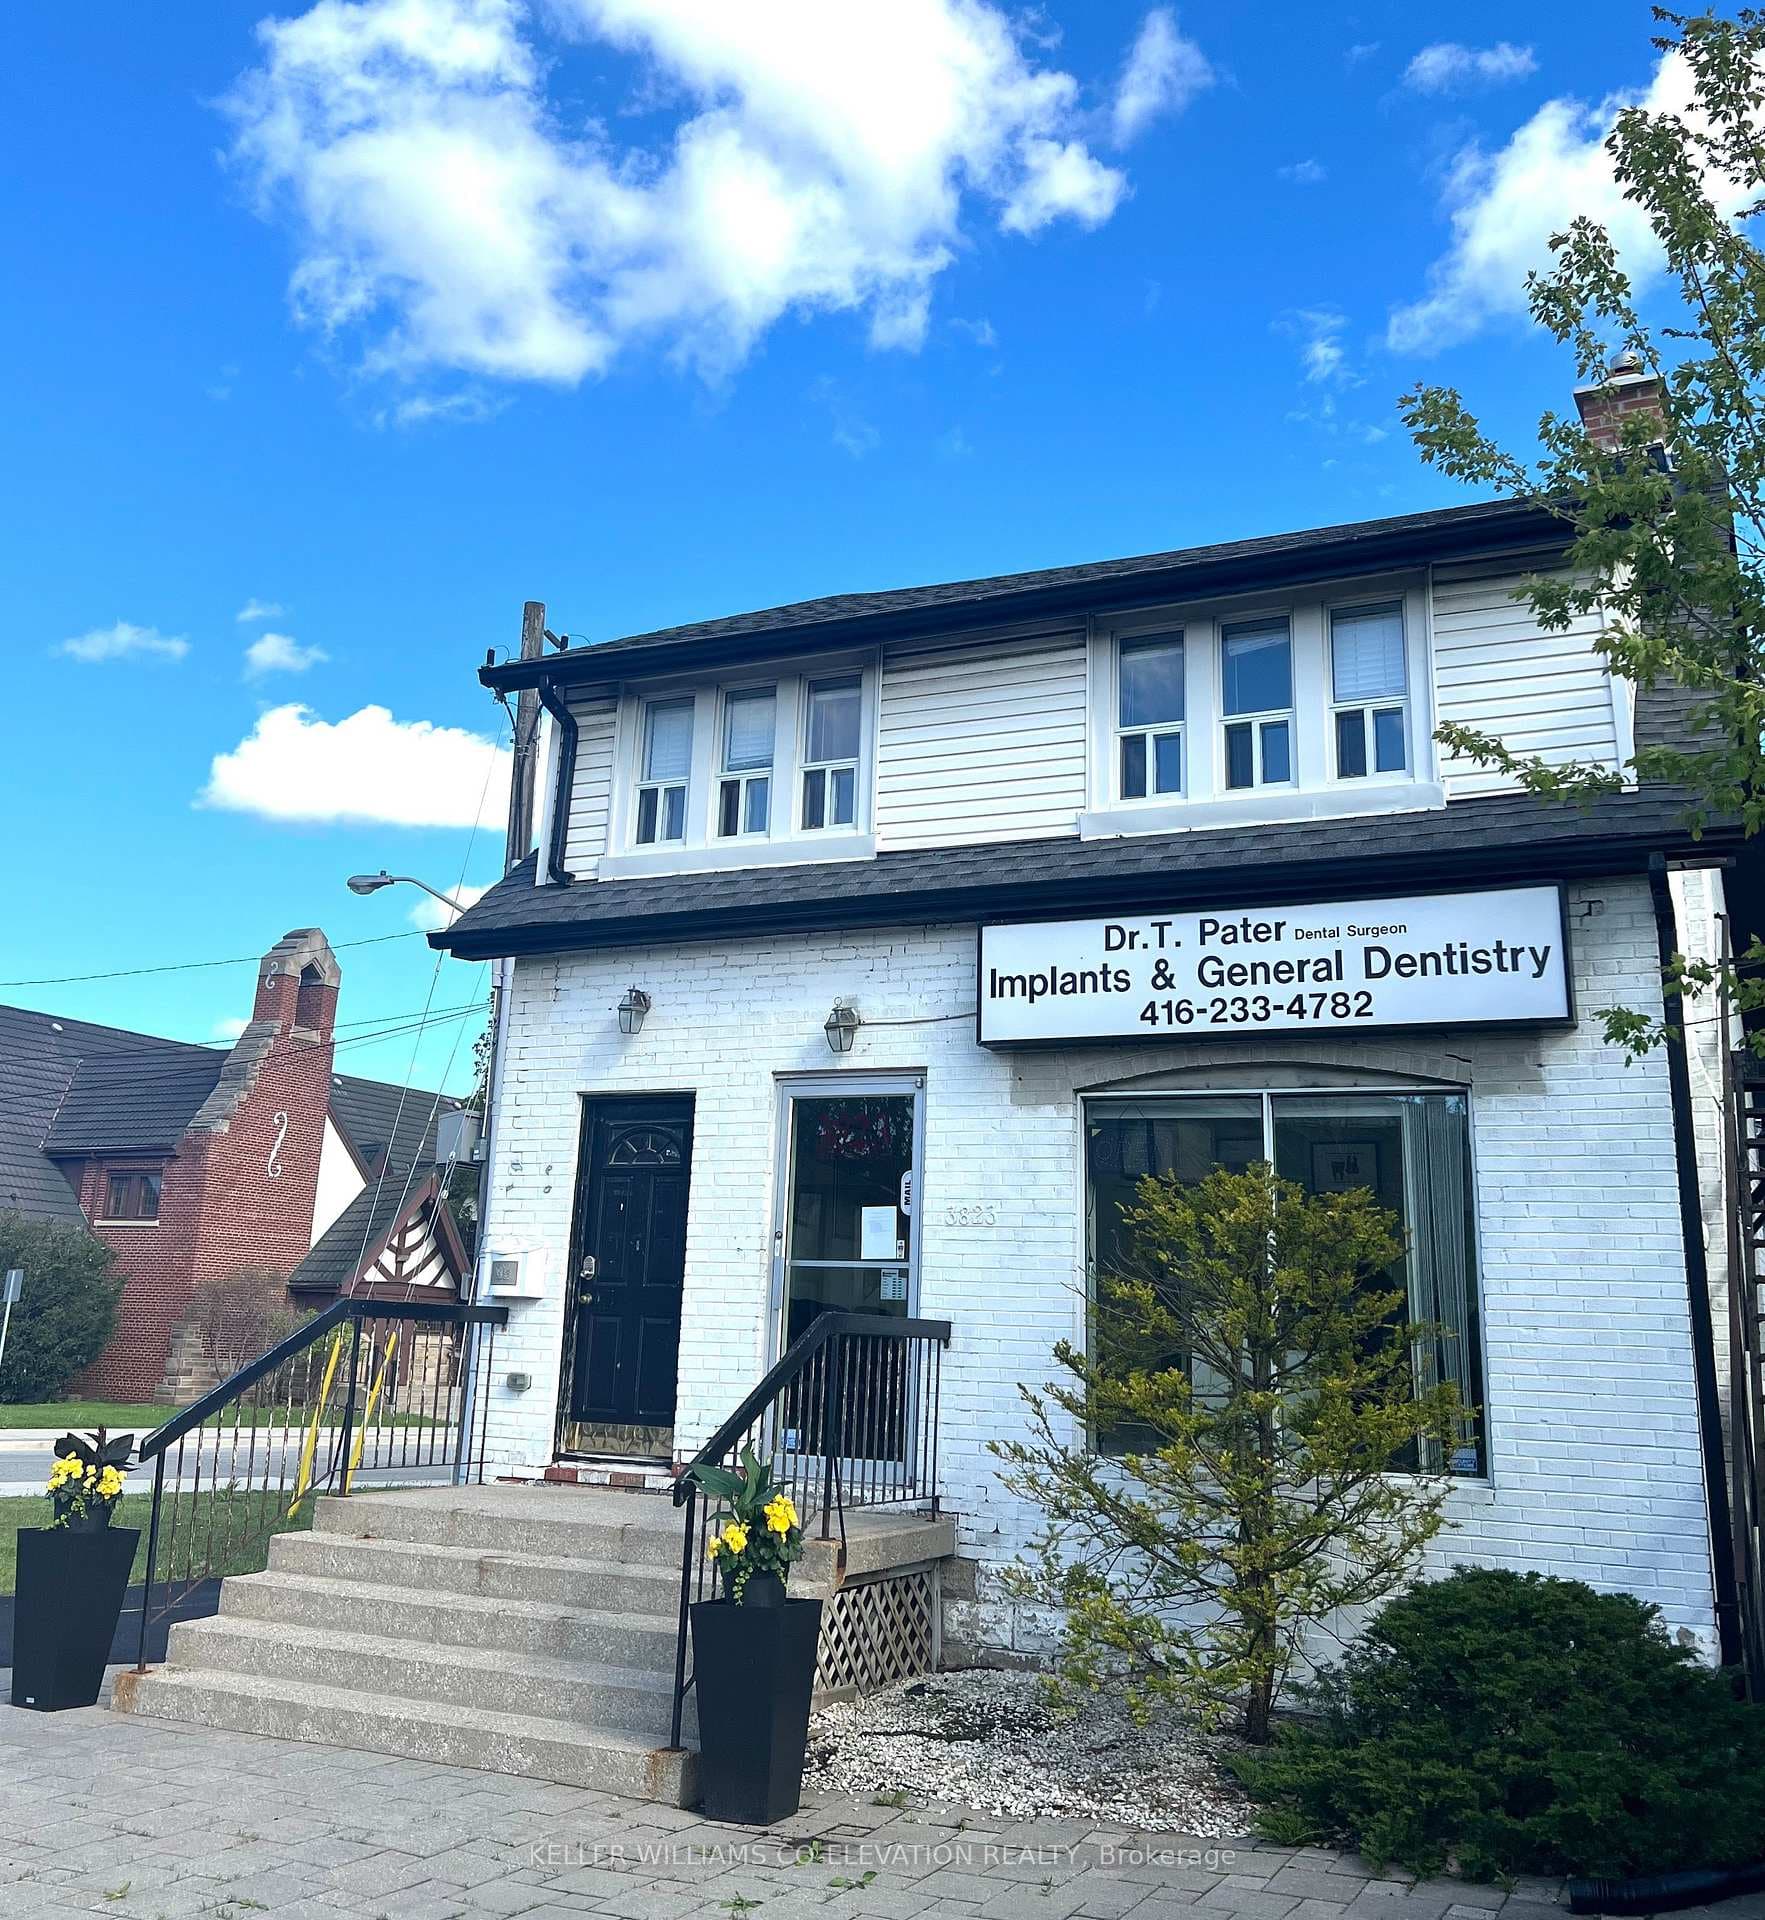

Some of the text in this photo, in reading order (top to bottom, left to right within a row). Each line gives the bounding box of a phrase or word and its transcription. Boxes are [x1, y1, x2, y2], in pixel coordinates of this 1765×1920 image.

[1199, 917, 1287, 946] Pater
[1294, 924, 1407, 940] Dental Surgeon
[990, 940, 1552, 1004] Implants & General Dentistry
[1139, 990, 1374, 1026] 416-233-4782
[903, 1180, 912, 1206] MAIL
